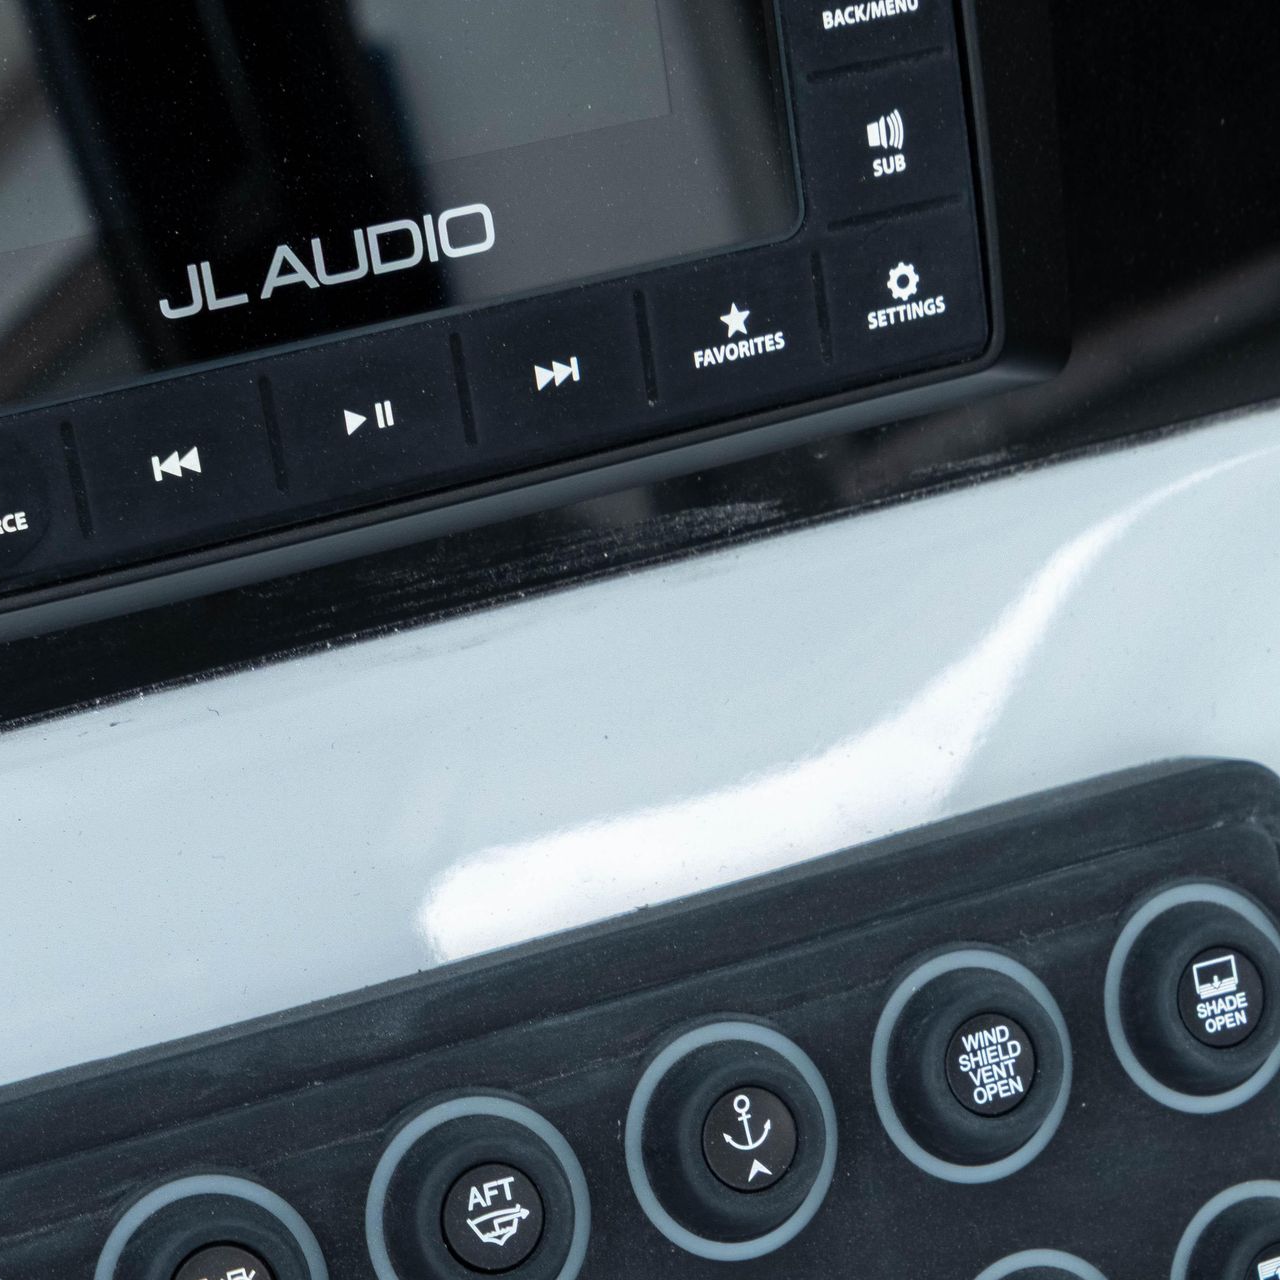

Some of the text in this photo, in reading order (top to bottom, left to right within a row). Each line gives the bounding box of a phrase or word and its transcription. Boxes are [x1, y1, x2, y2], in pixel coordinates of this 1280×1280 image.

[822, 0, 919, 29] BACK/MENU
[872, 153, 907, 178] SUB
[159, 203, 496, 320] JL AUDIO
[867, 295, 946, 330] SETTINGS
[693, 331, 786, 369] FAVORITES
[1196, 992, 1248, 1019] SHADE
[1205, 1009, 1247, 1033] OPEN
[961, 1025, 1010, 1053] WIND
[958, 1040, 1021, 1072] SHIELD
[968, 1058, 1016, 1087] VENT
[973, 1075, 1024, 1105] OPEN
[467, 1176, 515, 1212] AFT
